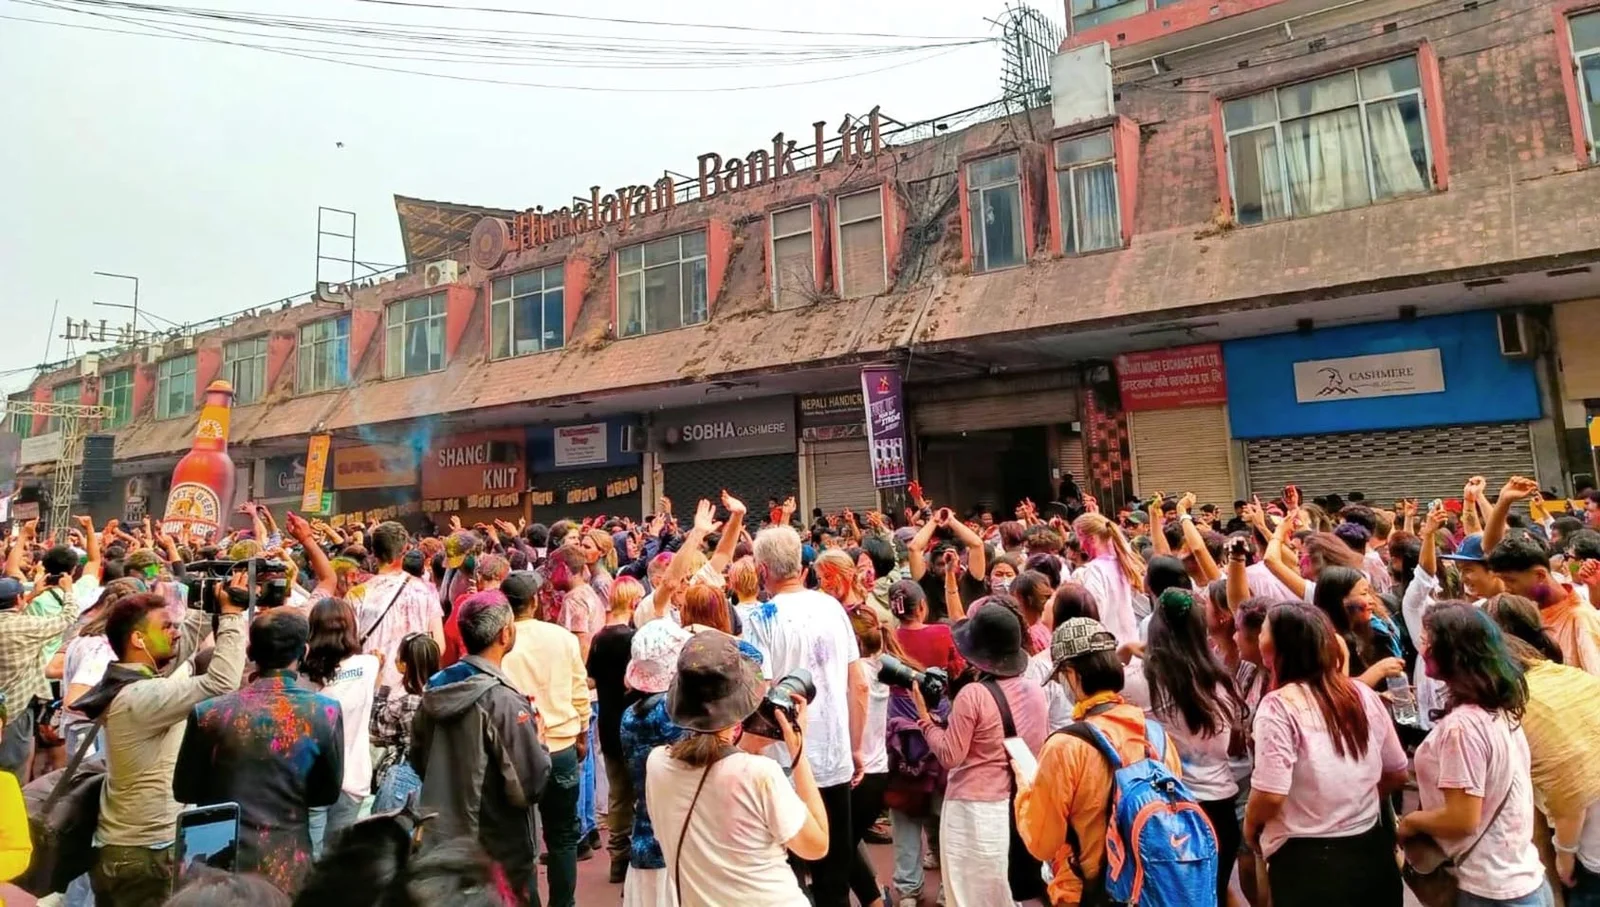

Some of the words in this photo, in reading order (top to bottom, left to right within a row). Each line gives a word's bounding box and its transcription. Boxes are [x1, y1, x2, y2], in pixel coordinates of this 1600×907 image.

[513, 176, 675, 251] Himalayan
[697, 132, 797, 200] Bank
[812, 105, 880, 170] Ltd
[1142, 360, 1160, 372] MONEY
[1162, 357, 1193, 370] EXCHANGE
[1349, 367, 1414, 381] CASHMERE
[801, 397, 827, 410] NEPALI
[829, 393, 863, 407] HANDICR
[683, 422, 735, 441] SOBHA
[737, 423, 785, 436] CASHMERE
[438, 444, 486, 467] SHANG
[482, 468, 518, 490] KNIT
[196, 492, 213, 516] BEER
